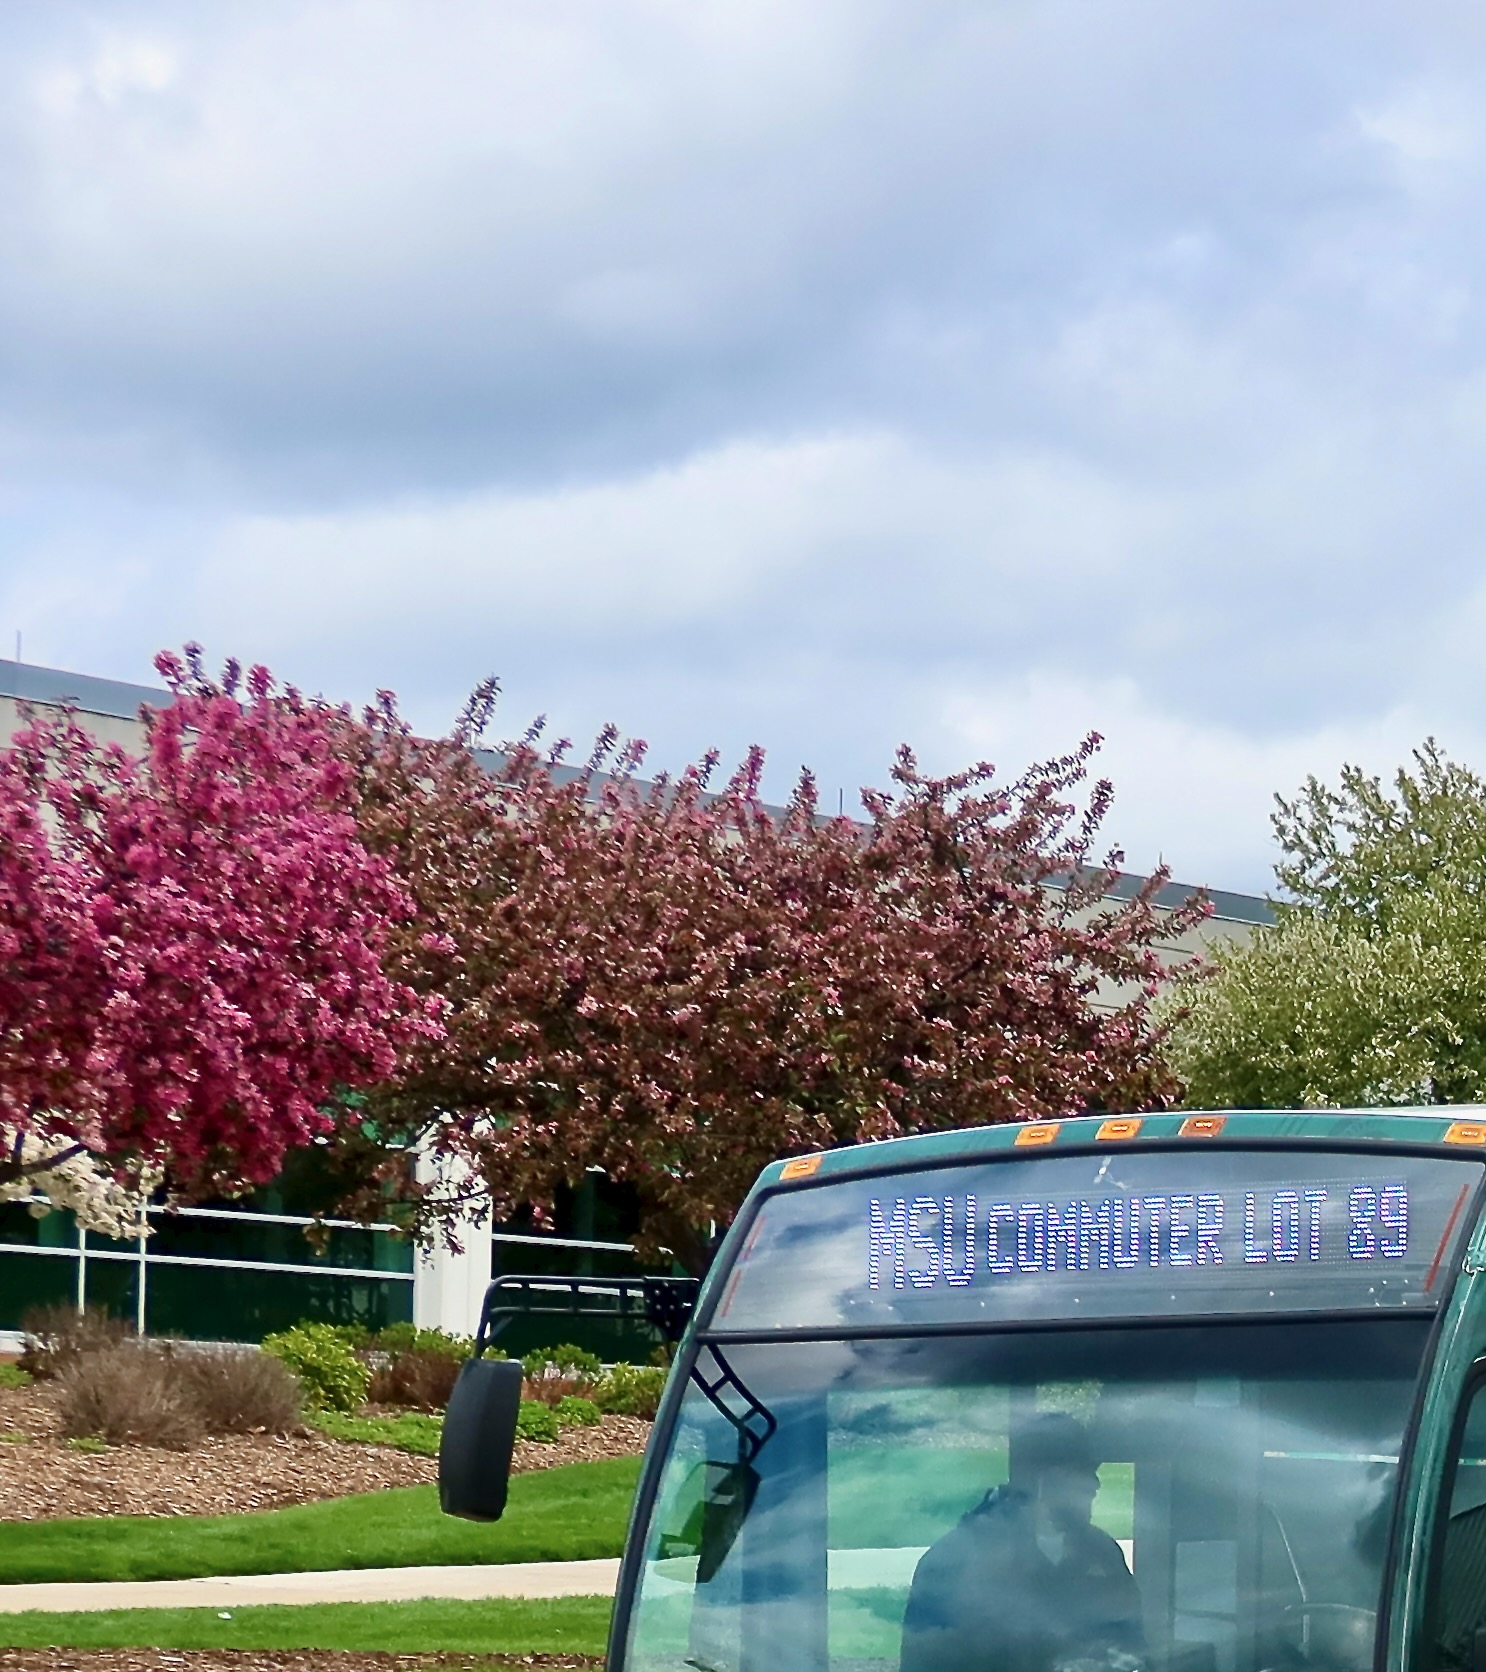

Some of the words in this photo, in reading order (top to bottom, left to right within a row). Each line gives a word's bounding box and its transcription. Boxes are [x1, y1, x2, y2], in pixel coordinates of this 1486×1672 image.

[869, 1195, 976, 1290] MSU
[987, 1193, 1224, 1274] COMMUTER
[1244, 1188, 1328, 1264] LOT
[1347, 1186, 1408, 1259] 89
